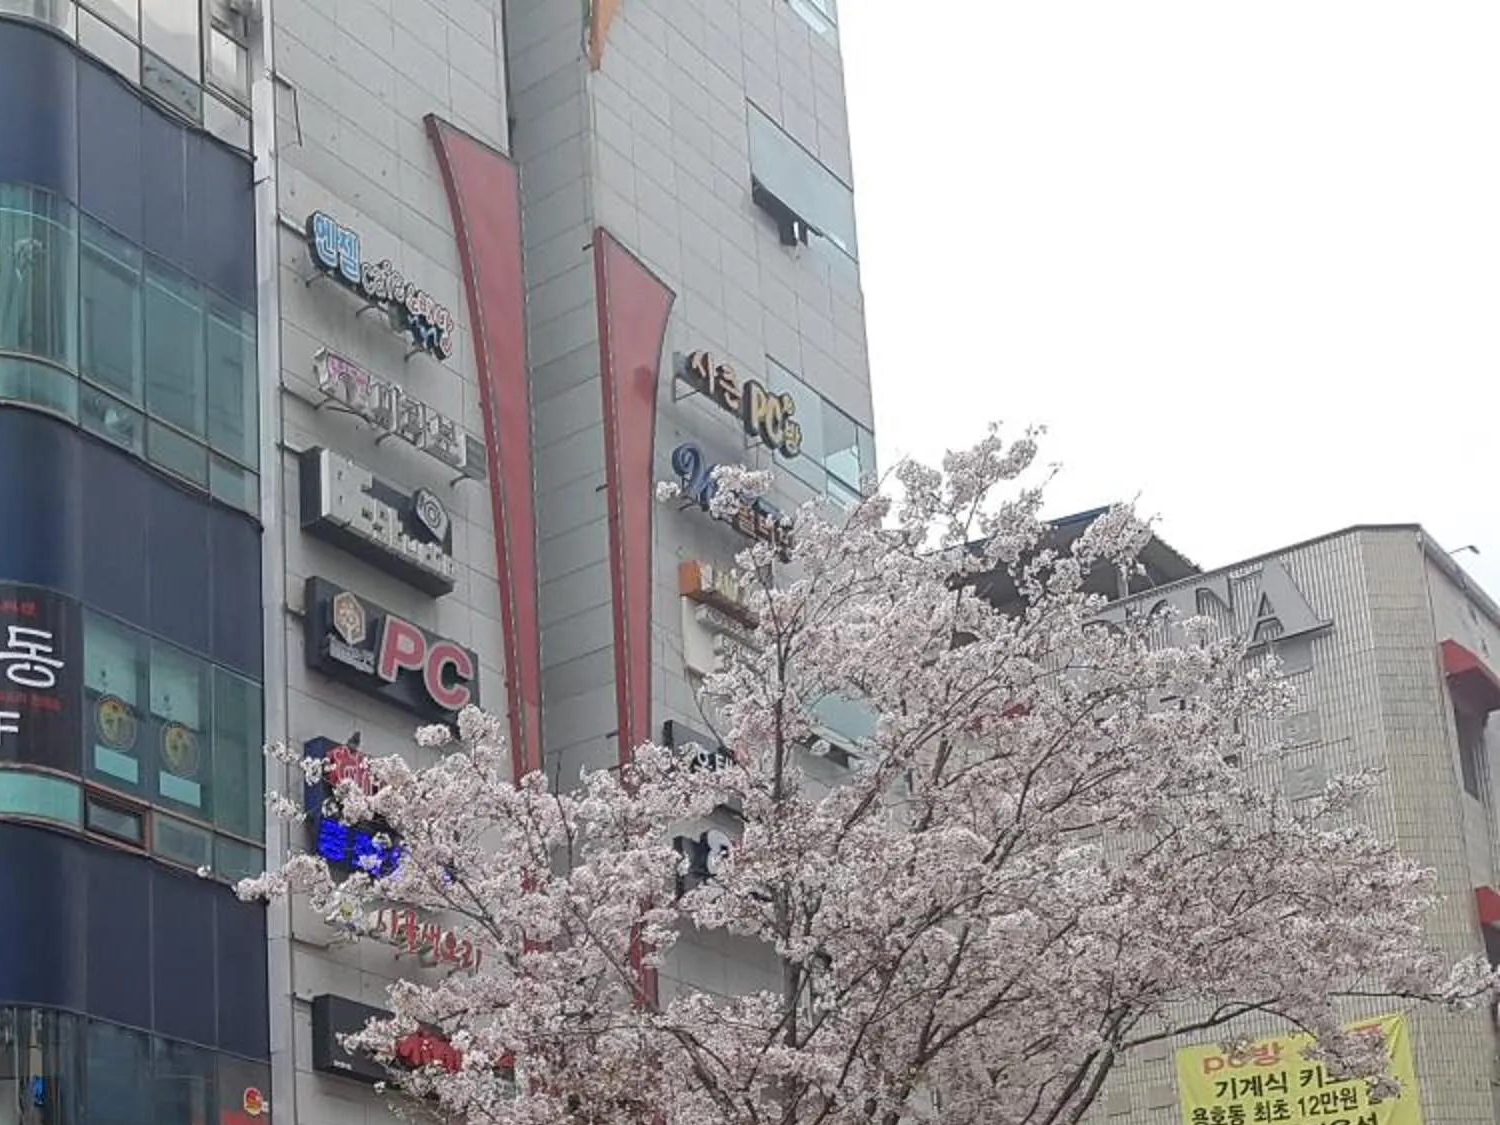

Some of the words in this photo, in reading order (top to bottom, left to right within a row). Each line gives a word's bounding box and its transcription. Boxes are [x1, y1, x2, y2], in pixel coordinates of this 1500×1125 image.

[377, 613, 474, 710] PC
[1215, 1070, 1289, 1101] 기계식
[1253, 1098, 1293, 1124] 최초
[1297, 1086, 1358, 1118] 12만원
